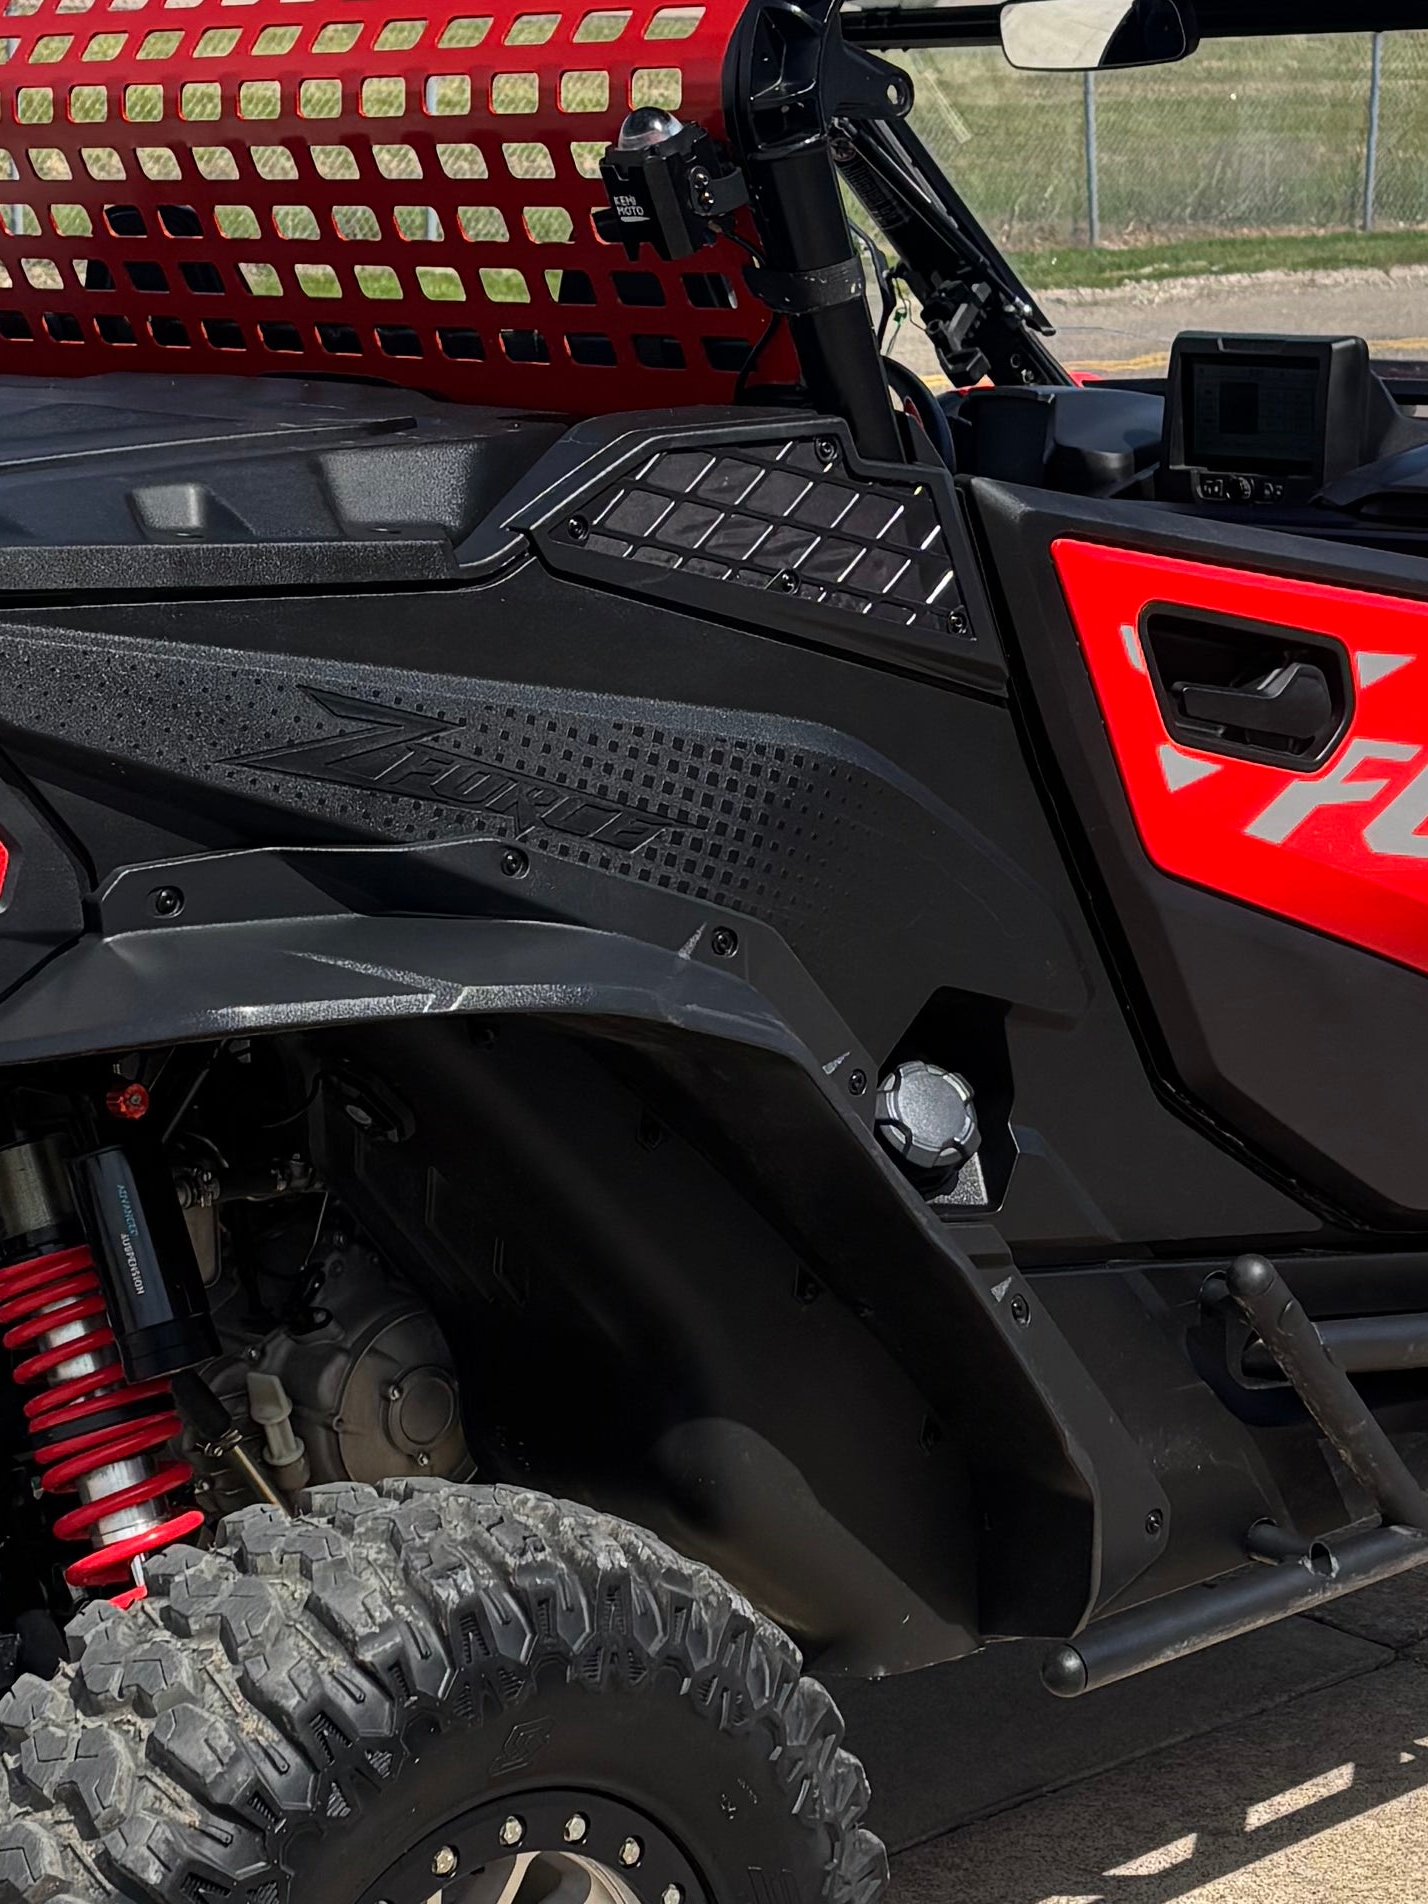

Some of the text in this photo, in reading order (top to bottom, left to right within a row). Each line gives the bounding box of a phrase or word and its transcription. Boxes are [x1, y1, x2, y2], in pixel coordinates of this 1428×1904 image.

[614, 194, 637, 206] KEMI
[616, 206, 644, 216] MOTO
[120, 1233, 145, 1295] SUSPENSION
